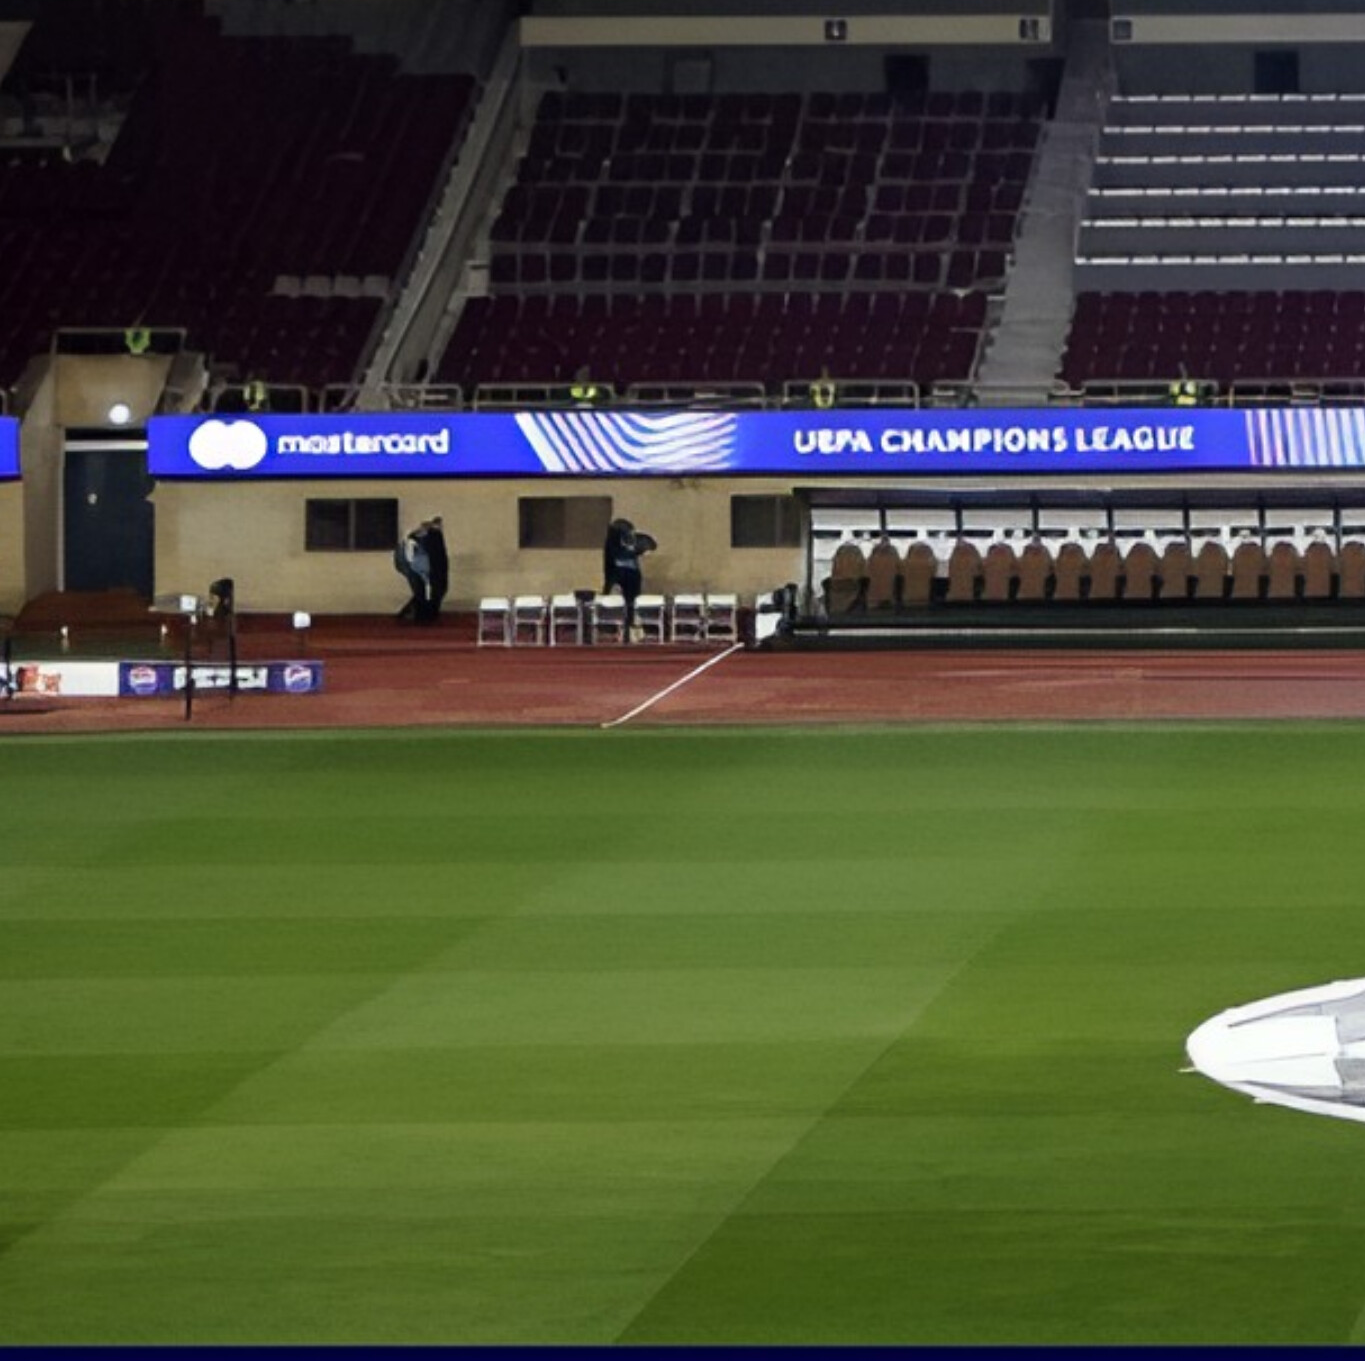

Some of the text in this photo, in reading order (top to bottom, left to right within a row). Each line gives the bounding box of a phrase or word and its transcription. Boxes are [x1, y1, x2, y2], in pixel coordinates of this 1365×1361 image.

[278, 429, 449, 454] mastercard
[794, 426, 1194, 453] UEFA CHAMPIONS LEAGUE
